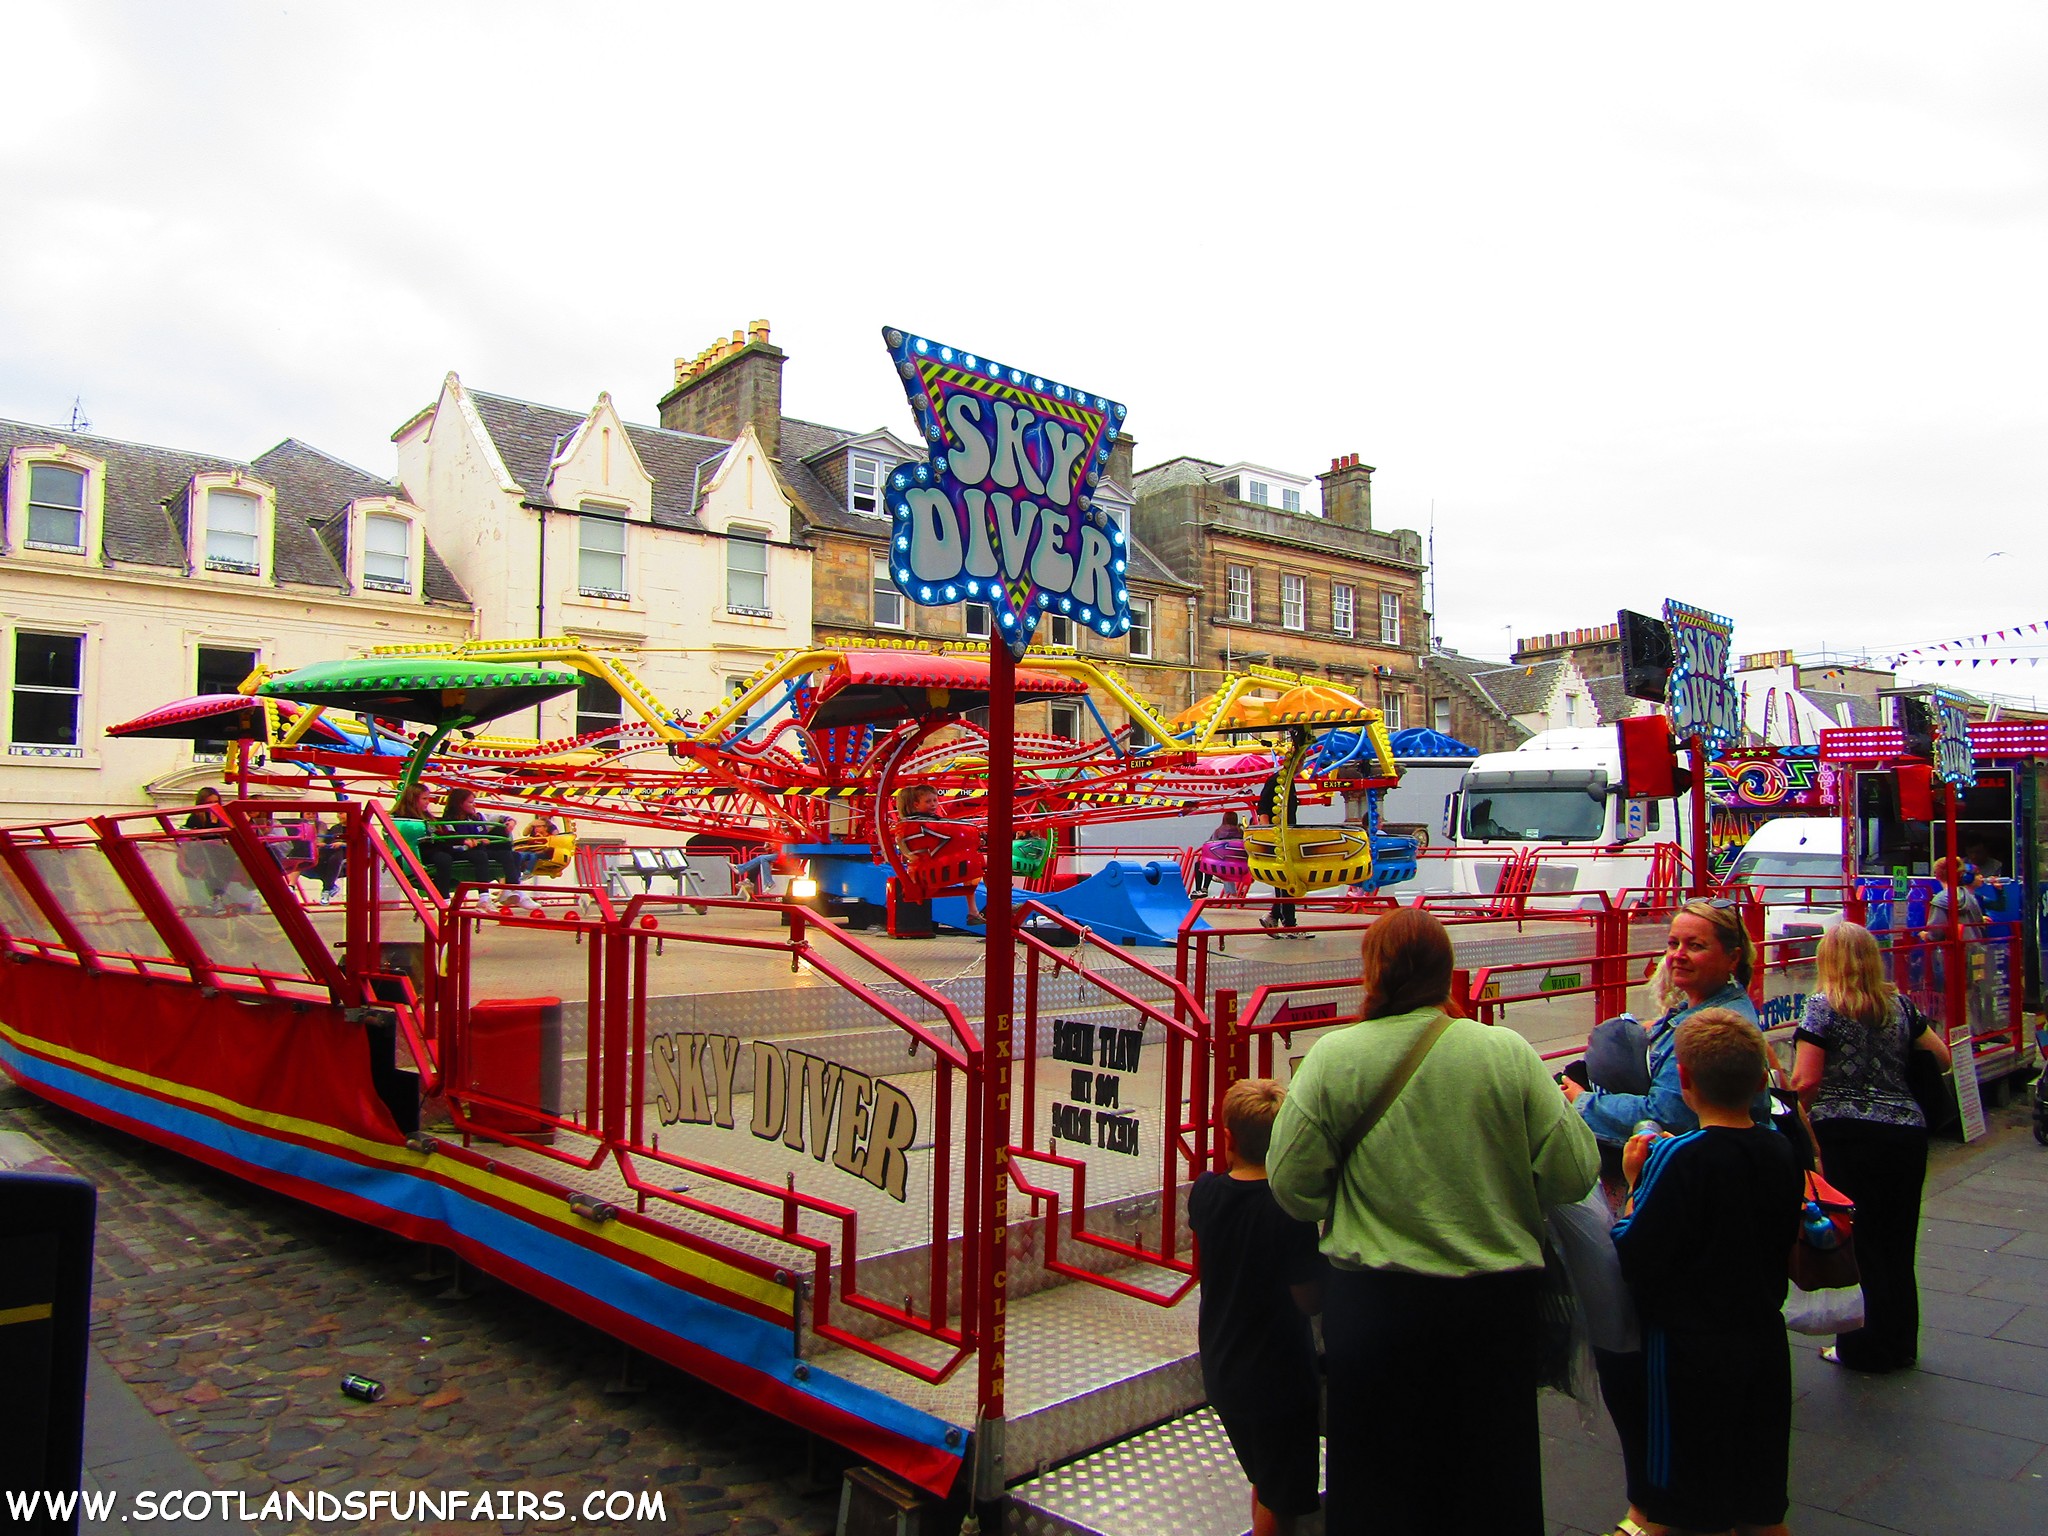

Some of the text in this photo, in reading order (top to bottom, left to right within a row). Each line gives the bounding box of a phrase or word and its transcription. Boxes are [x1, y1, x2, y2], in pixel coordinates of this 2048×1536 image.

[946, 394, 1086, 506] SKY
[906, 487, 1116, 616] DIVER
[1683, 628, 1723, 680] SKY
[1675, 676, 1736, 737] DIVER
[1130, 760, 1145, 768] EXIT
[1551, 977, 1577, 990] WAY IN
[1227, 998, 1238, 1081] EXIT
[651, 1032, 917, 1203] SKY DIVER
[991, 1014, 1010, 1397] EXIT KEEP CLEAR
